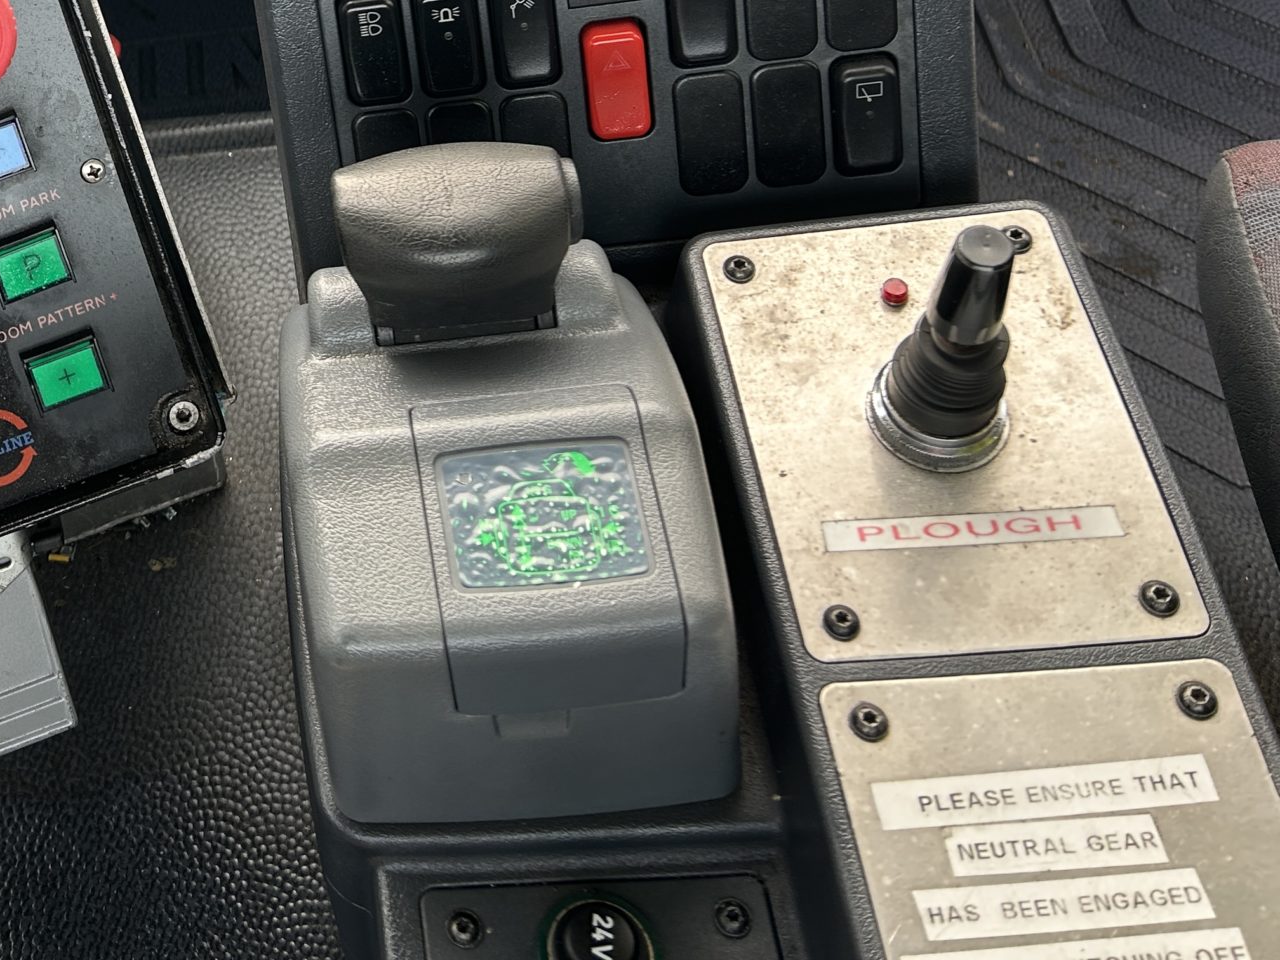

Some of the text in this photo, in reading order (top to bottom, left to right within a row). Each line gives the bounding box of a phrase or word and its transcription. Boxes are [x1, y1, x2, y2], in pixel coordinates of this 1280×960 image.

[19, 188, 62, 214] PARK
[37, 294, 107, 330] PATTERN
[856, 513, 1084, 544] PLOUGH
[918, 770, 1201, 813] PLEASE ENSURE THAT
[956, 830, 1159, 861] NEUTRAL GEAR
[927, 885, 1204, 926] HAS BEEN ENGAGED
